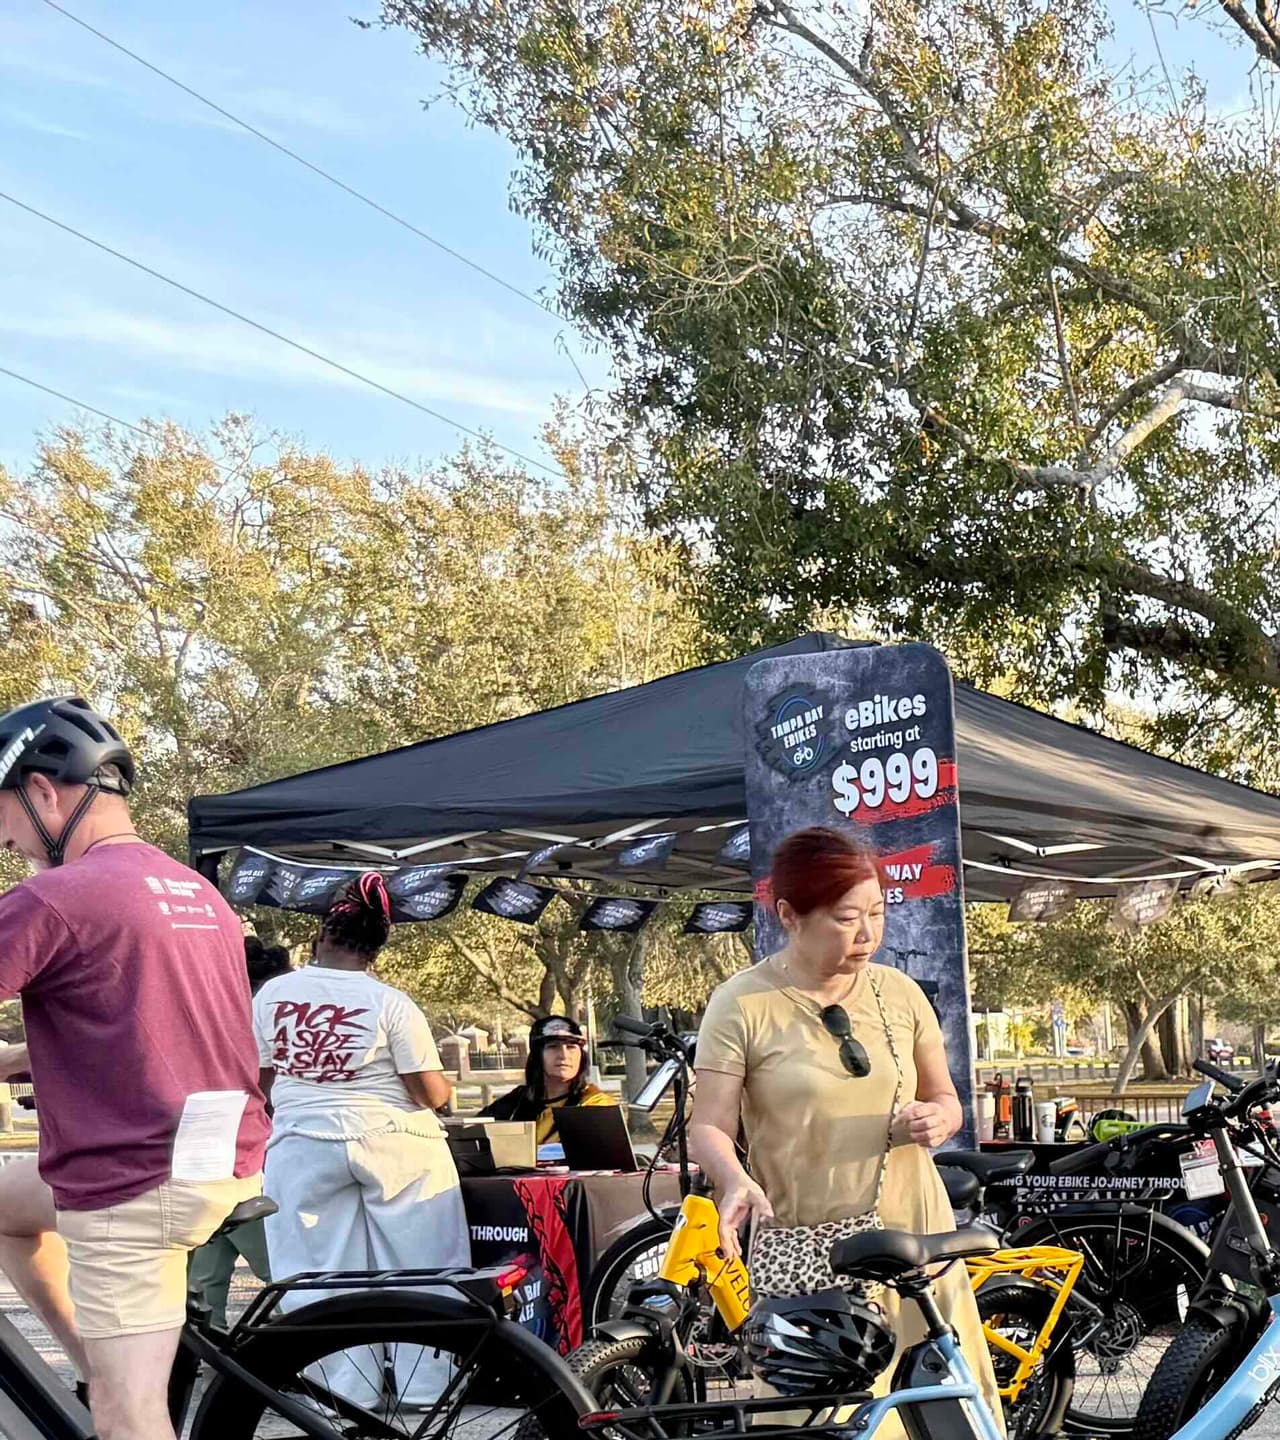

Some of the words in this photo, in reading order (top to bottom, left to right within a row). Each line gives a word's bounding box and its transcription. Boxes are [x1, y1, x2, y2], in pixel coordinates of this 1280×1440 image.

[770, 714, 804, 740] TAMPA
[804, 704, 824, 727] BAY
[845, 694, 926, 731] eBikes
[783, 724, 817, 749] EBIKES
[850, 731, 904, 753] starting
[905, 725, 921, 743] at
[832, 747, 938, 817] $999
[883, 887, 904, 904] ES
[266, 1001, 372, 1032] PICK
[269, 1026, 289, 1049] A
[291, 1028, 370, 1051] SIDE
[293, 1050, 352, 1073] STAY
[1025, 1175, 1057, 1188] YOUR
[1058, 1175, 1090, 1188] EBIKE
[470, 1225, 528, 1243] THROUGH
